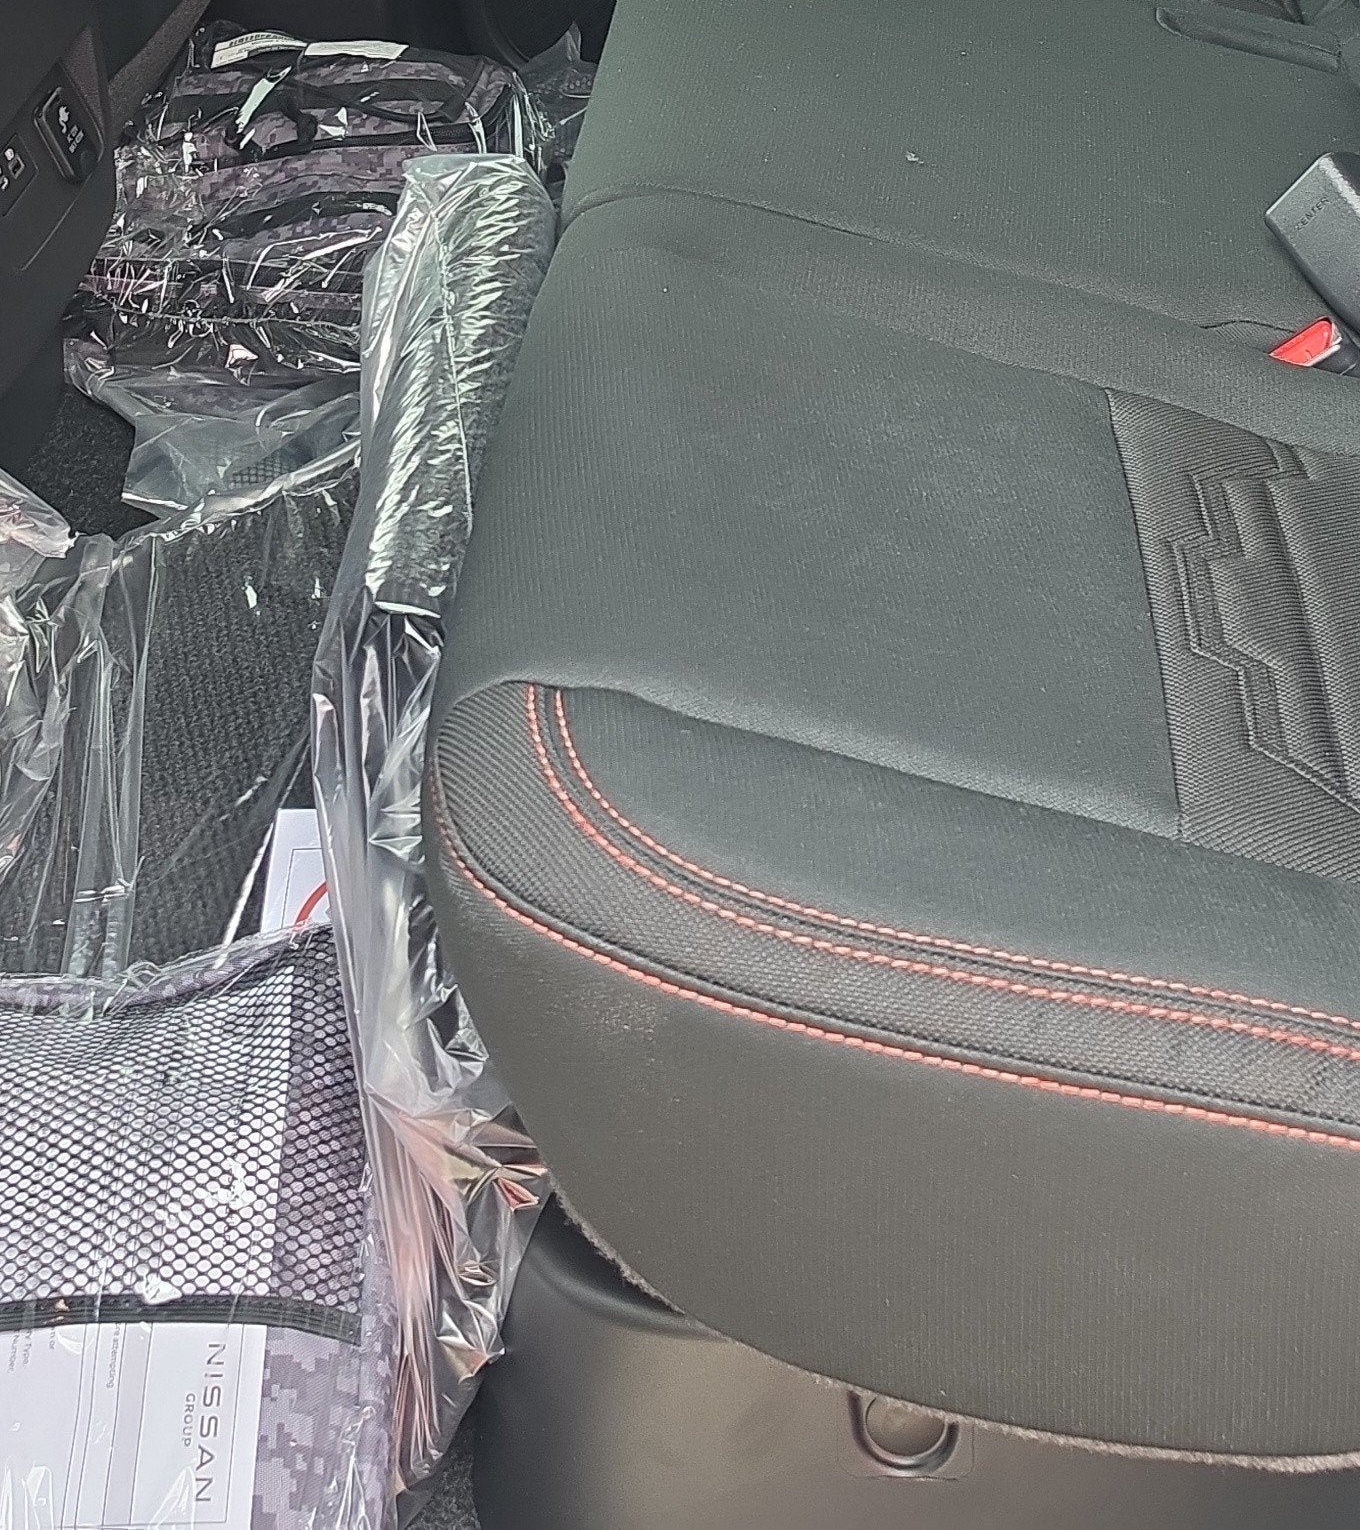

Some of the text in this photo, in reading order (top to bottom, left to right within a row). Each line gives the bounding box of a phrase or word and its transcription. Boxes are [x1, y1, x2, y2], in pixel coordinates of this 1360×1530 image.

[1295, 196, 1332, 231] CENTER
[106, 1338, 119, 1388] attempting
[182, 1392, 196, 1448] GROUP
[194, 1343, 227, 1502] NISSAN
